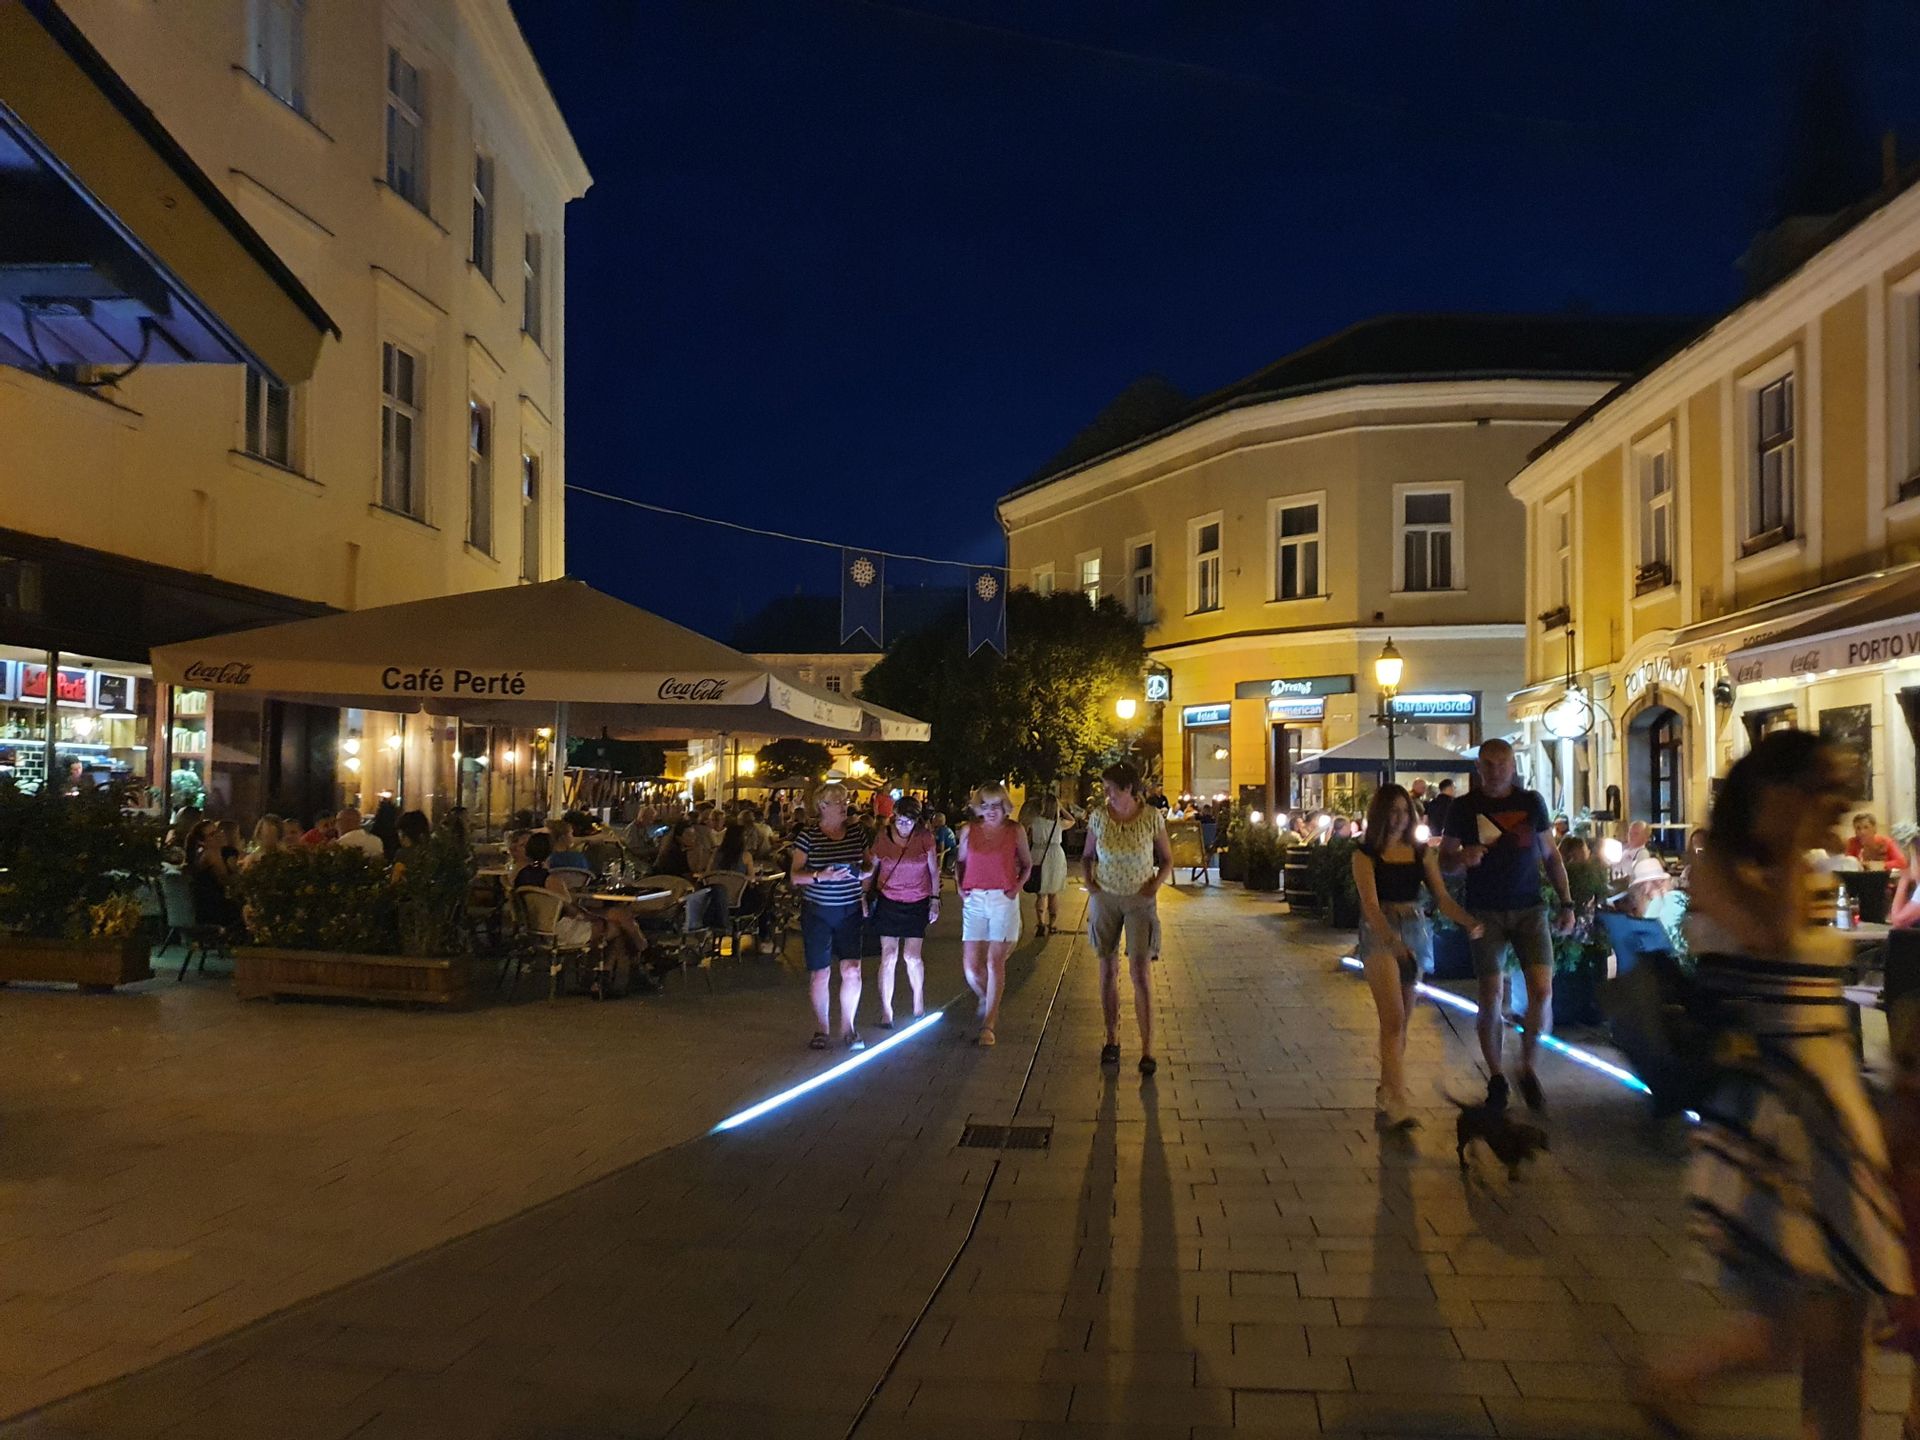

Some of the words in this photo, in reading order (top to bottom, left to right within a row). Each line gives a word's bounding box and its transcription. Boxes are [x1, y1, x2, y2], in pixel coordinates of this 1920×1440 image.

[1848, 635, 1904, 664] PORTO
[382, 667, 444, 692] Café
[454, 670, 526, 695] Perté
[658, 677, 728, 700] Coca-Cola
